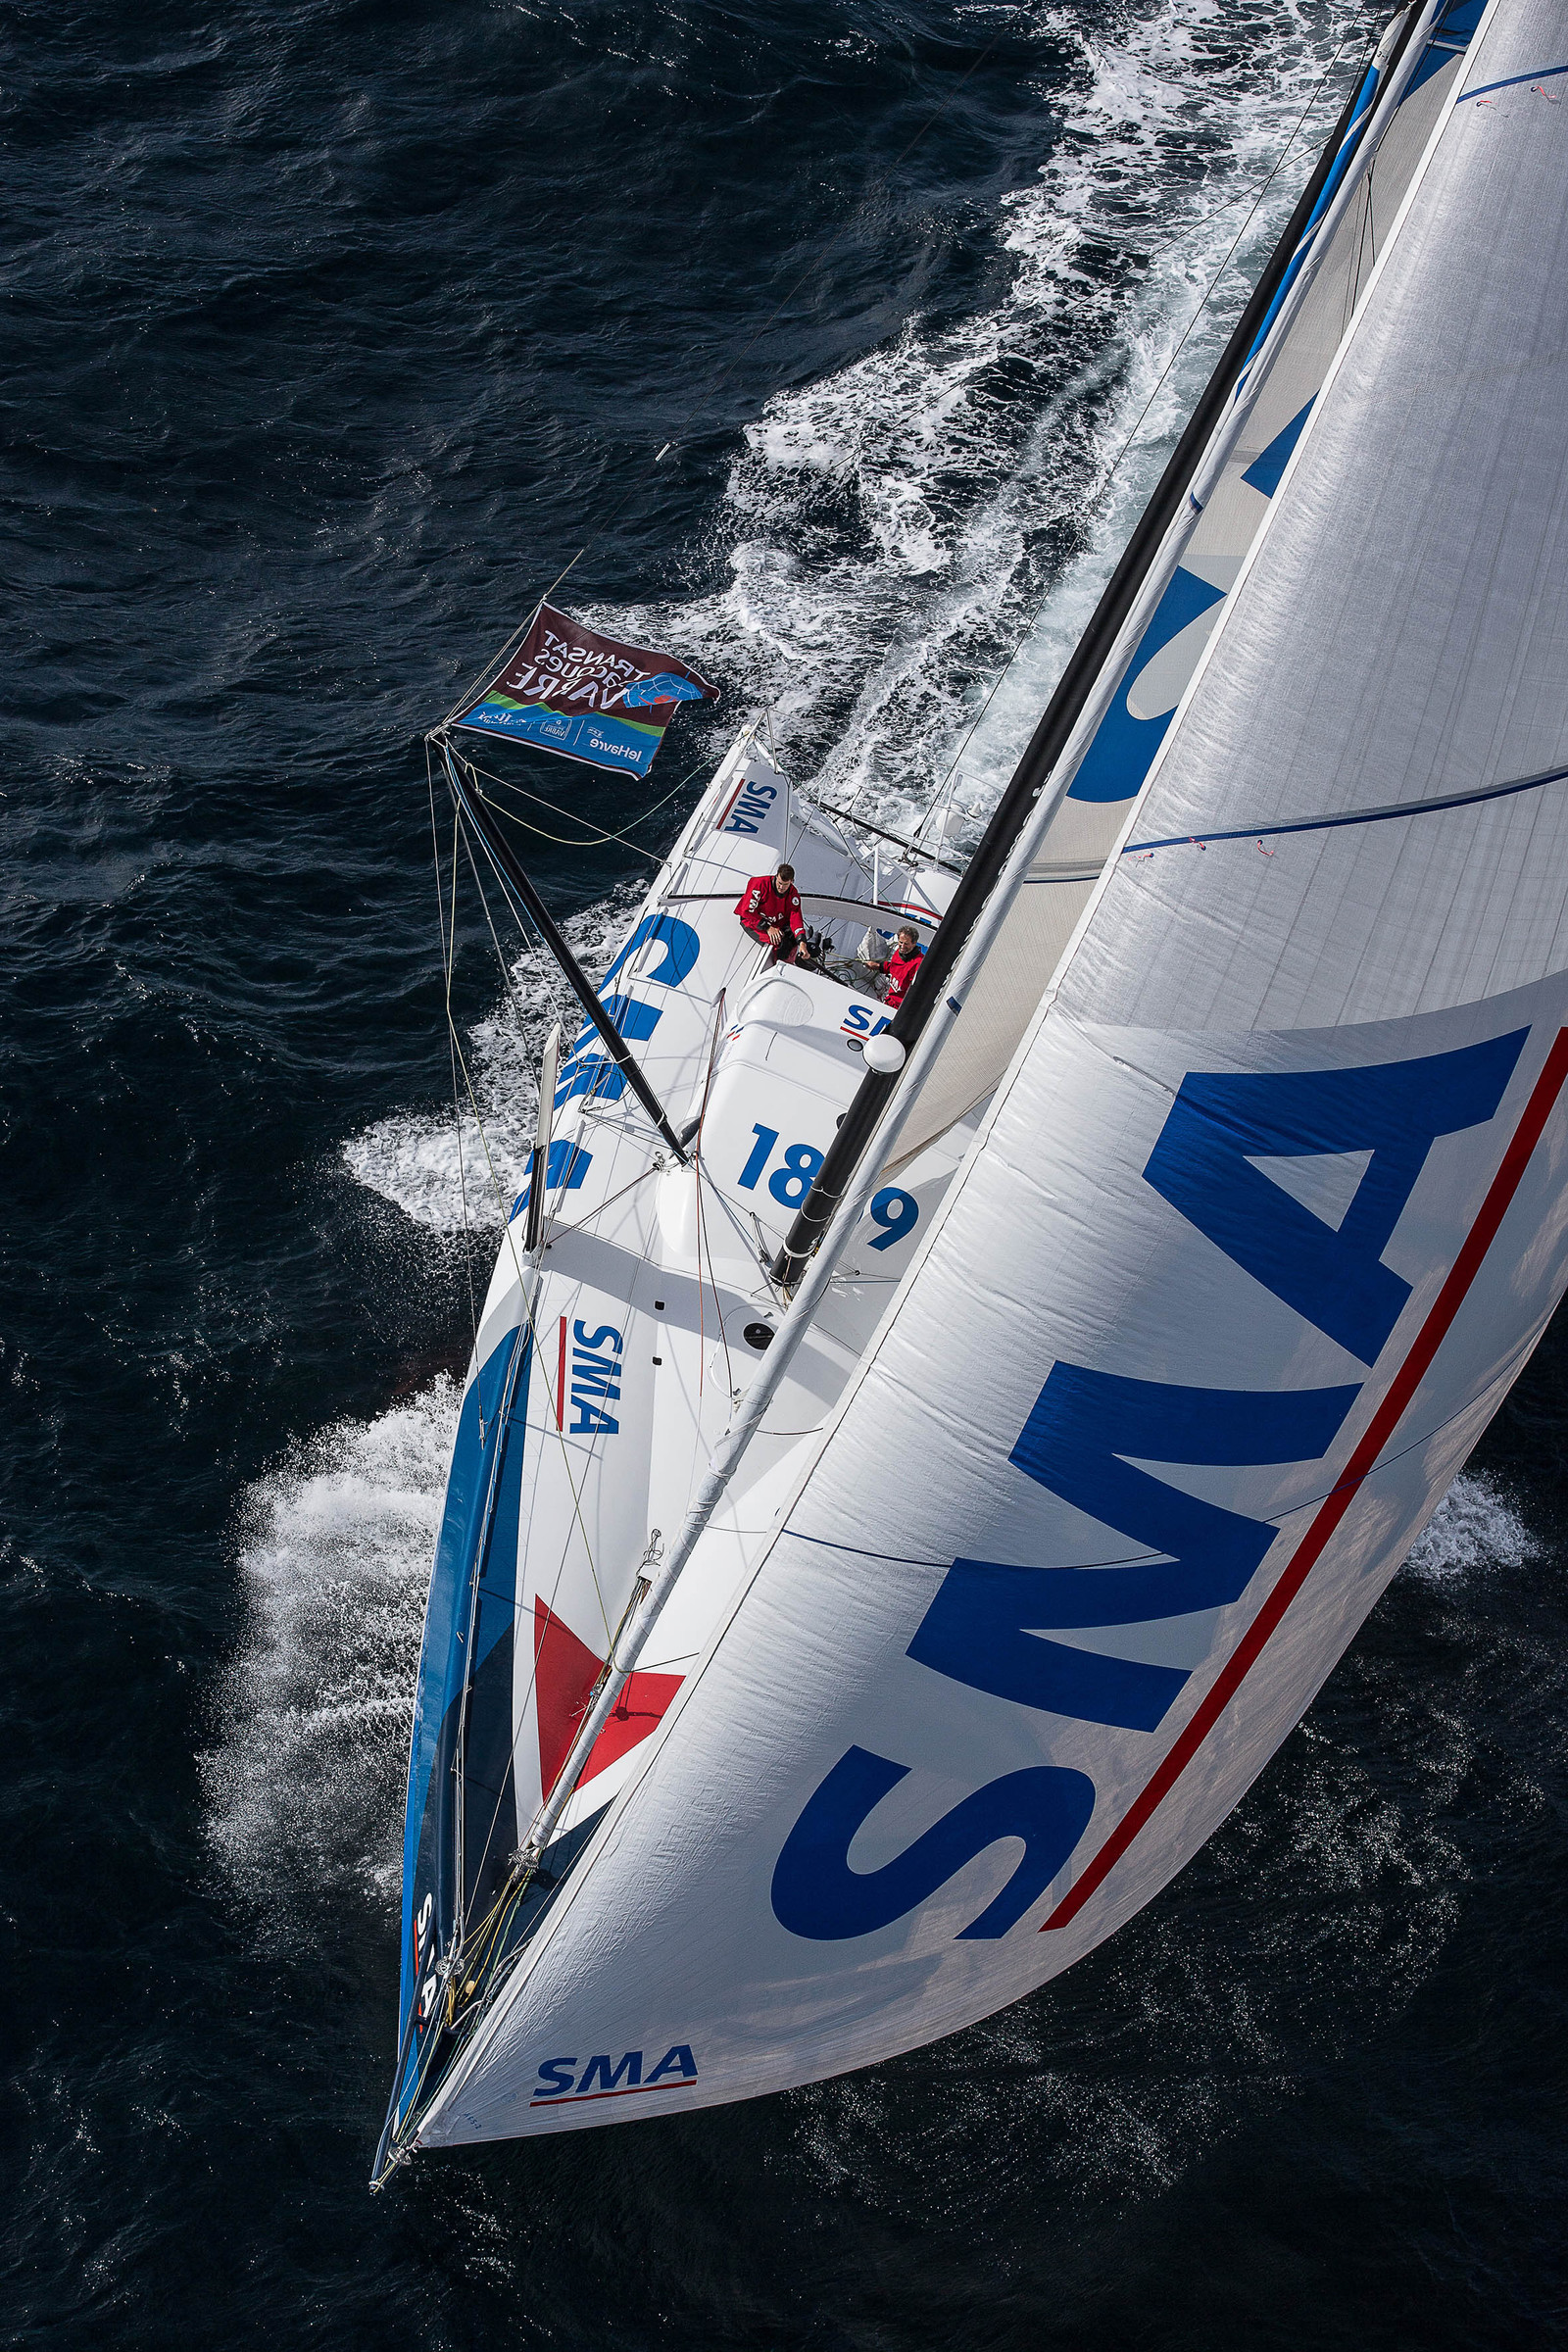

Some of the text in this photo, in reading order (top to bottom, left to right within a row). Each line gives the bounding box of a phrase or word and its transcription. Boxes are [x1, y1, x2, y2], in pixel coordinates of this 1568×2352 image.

[726, 781, 778, 835] SMA
[737, 1123, 919, 1252] 189
[569, 1319, 623, 1436] SMA
[770, 1024, 1530, 1940] SMA
[533, 2044, 699, 2097] SMA
